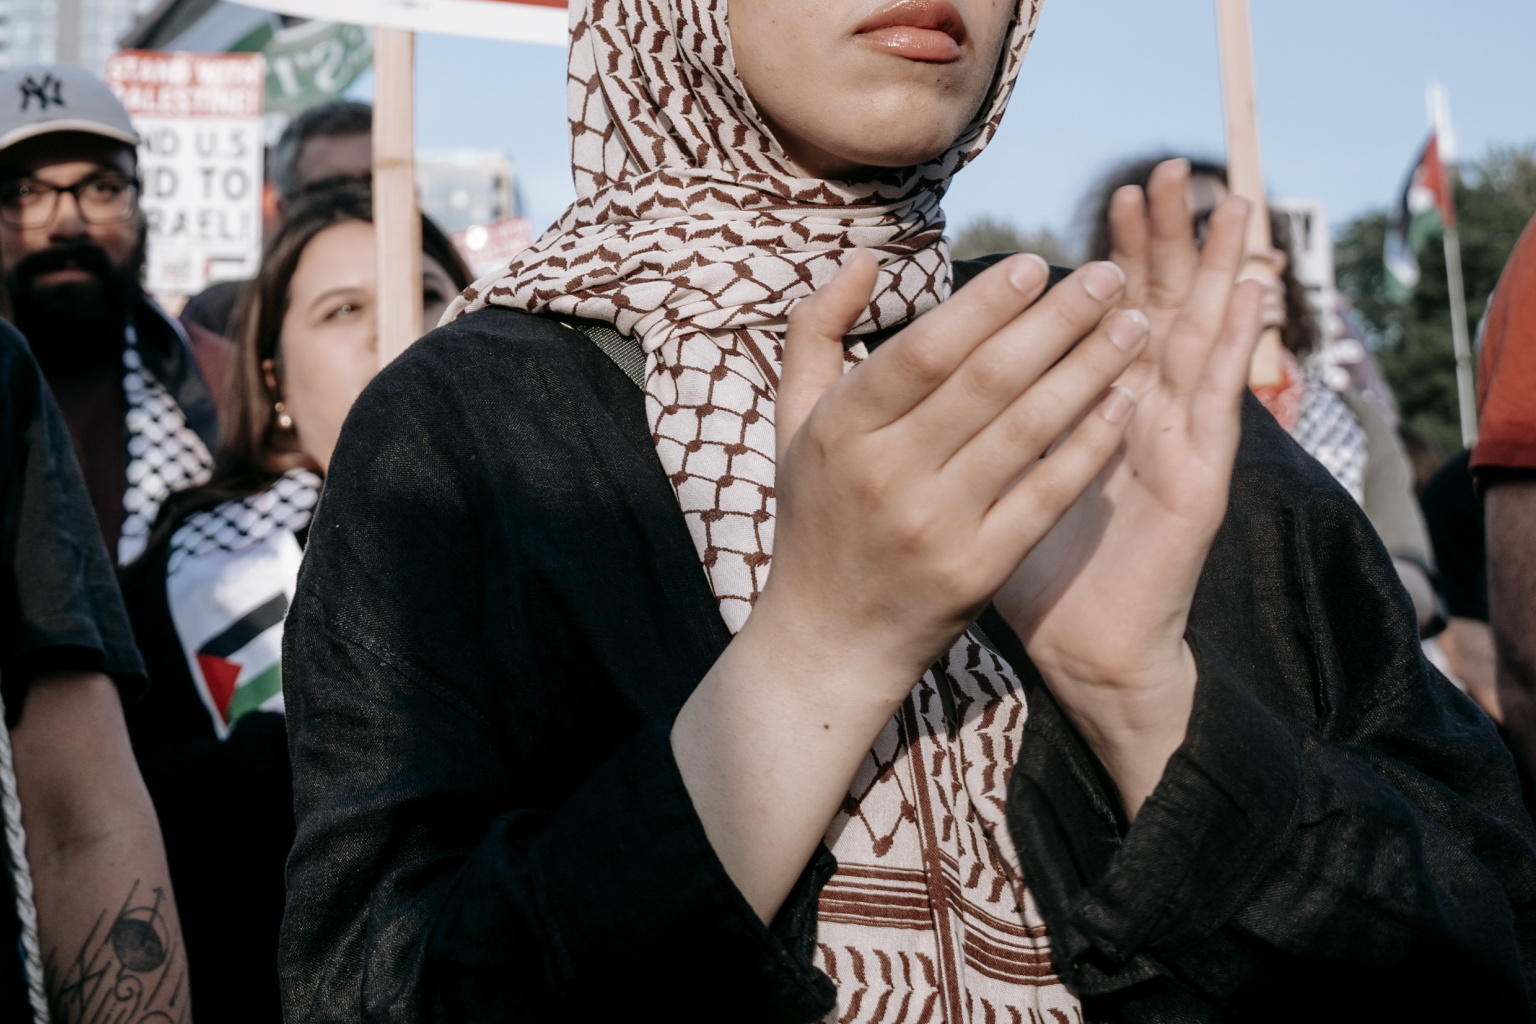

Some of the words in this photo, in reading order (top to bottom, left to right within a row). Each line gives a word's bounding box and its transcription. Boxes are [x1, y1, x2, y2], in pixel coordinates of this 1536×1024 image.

[19, 73, 67, 110] NY
[139, 127, 180, 157] ND
[143, 167, 180, 200] ID
[200, 166, 252, 200] TO
[146, 209, 251, 240] RAEL!
